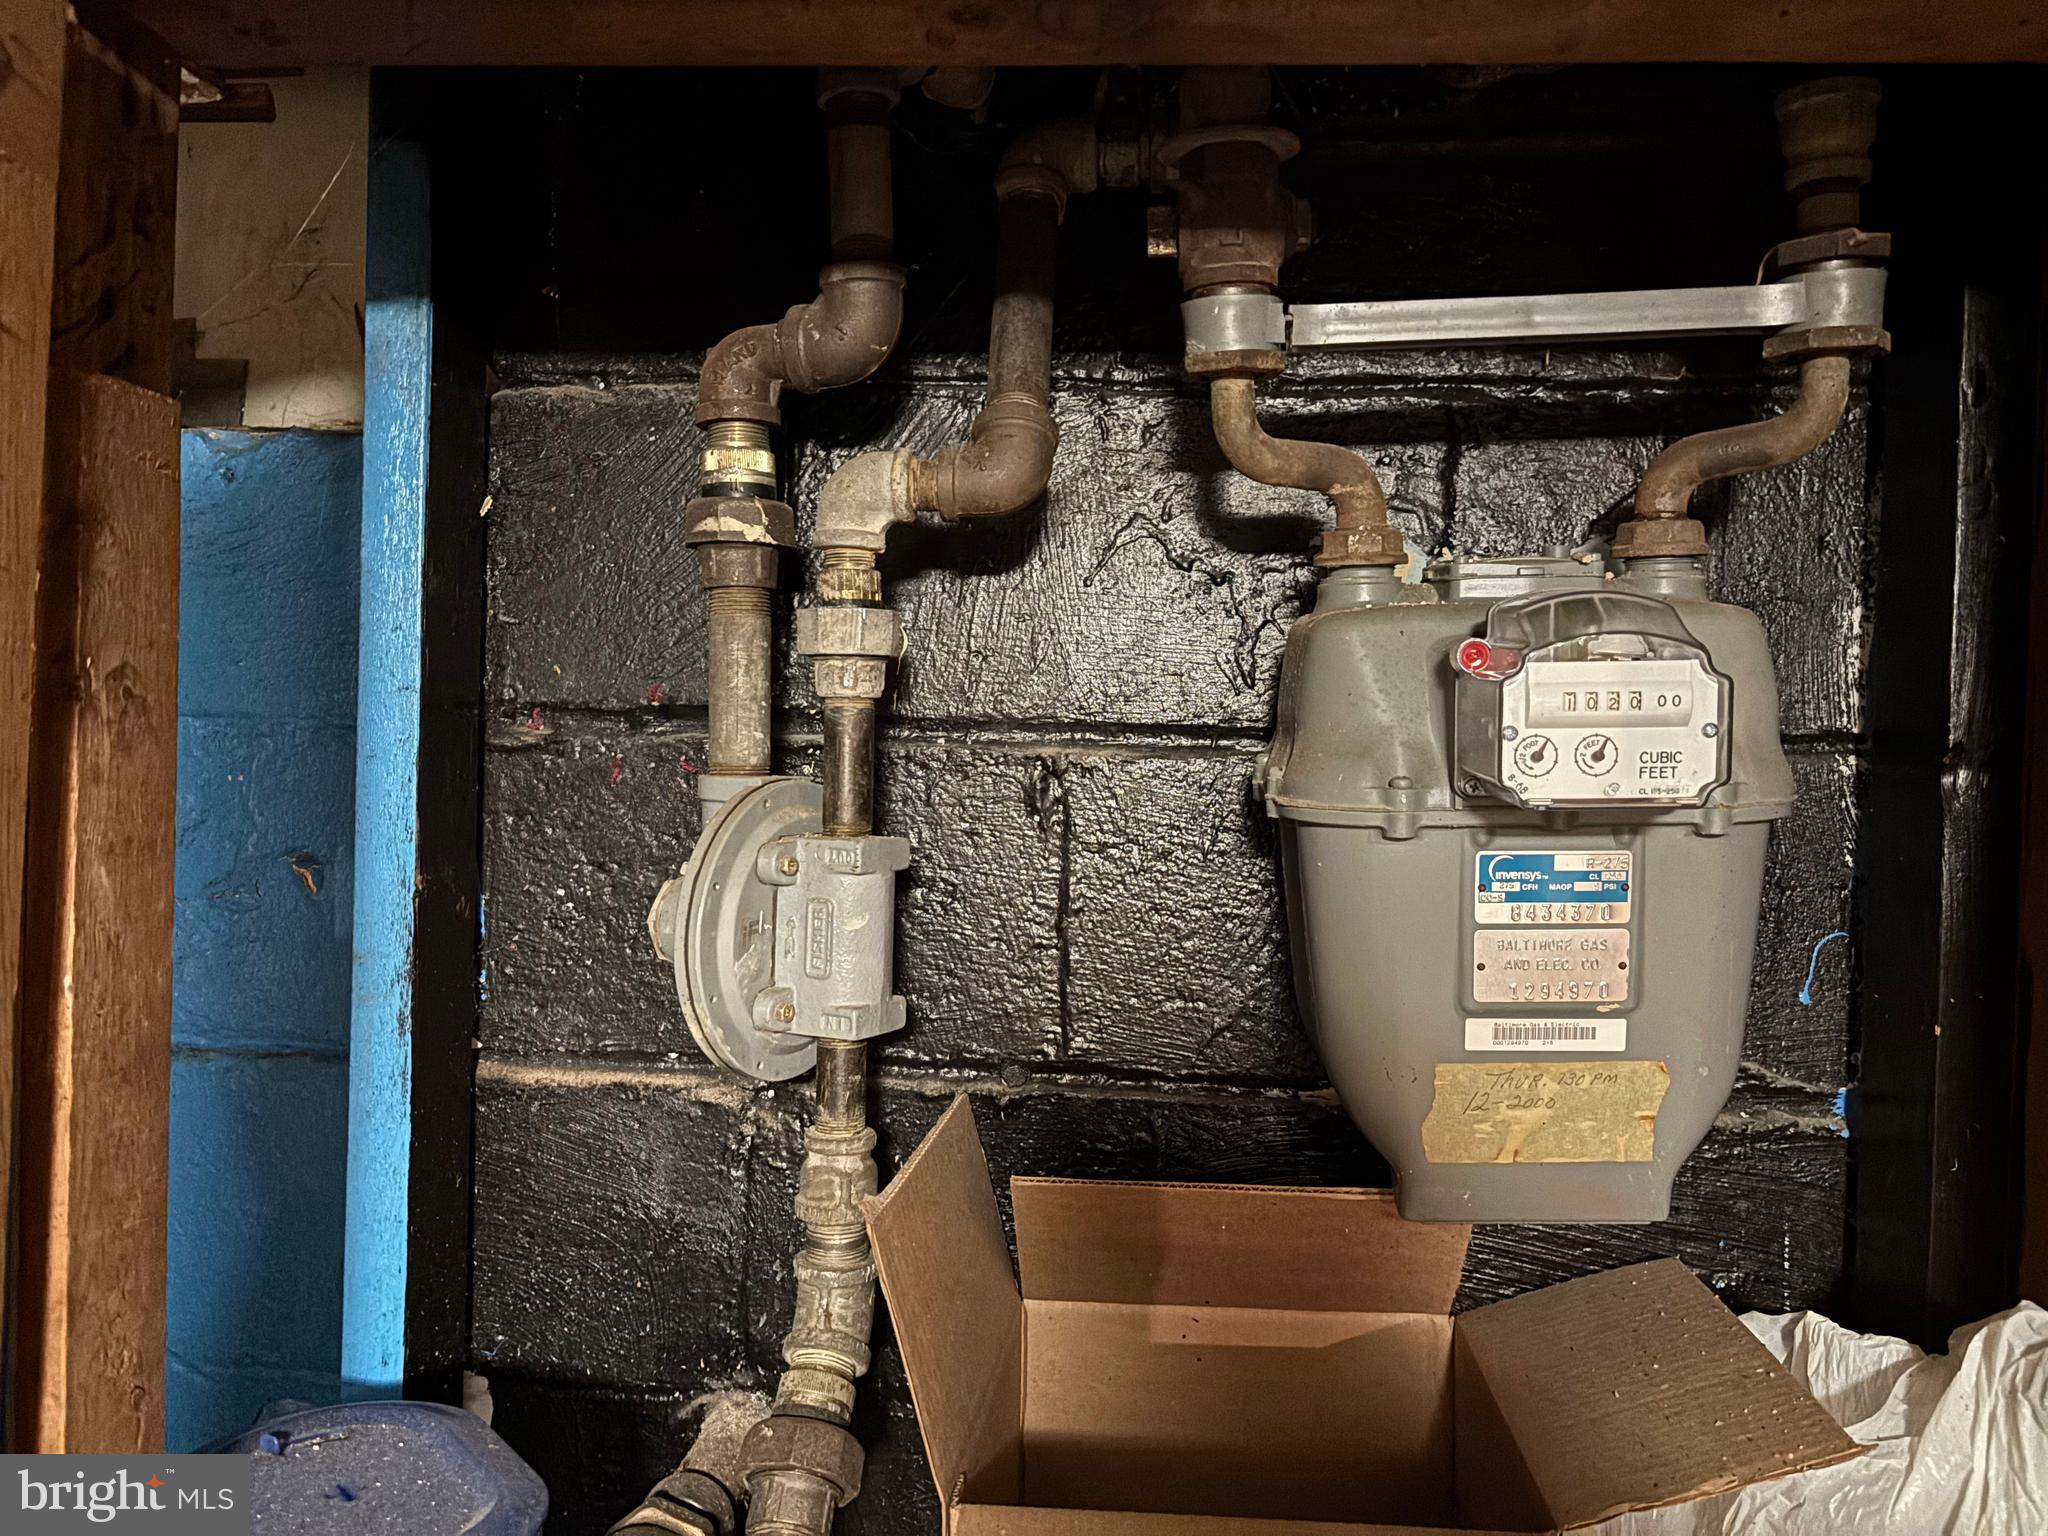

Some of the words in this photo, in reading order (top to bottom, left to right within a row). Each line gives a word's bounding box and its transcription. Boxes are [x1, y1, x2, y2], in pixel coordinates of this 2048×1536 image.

[1522, 740, 1539, 752] FOOT
[1583, 739, 1601, 751] FEET
[1639, 751, 1683, 764] CUBIC
[1639, 766, 1678, 779] FEET
[1588, 873, 1600, 881] CL
[1521, 883, 1538, 891] CFH
[1549, 883, 1573, 891] MAOP
[1510, 904, 1611, 922] 8434370
[1497, 939, 1572, 952] BALTIMORE
[1580, 938, 1608, 951] GAS
[1504, 959, 1531, 971] AND
[1508, 980, 1609, 1001] 1294970
[1590, 1073, 1618, 1086] PM
